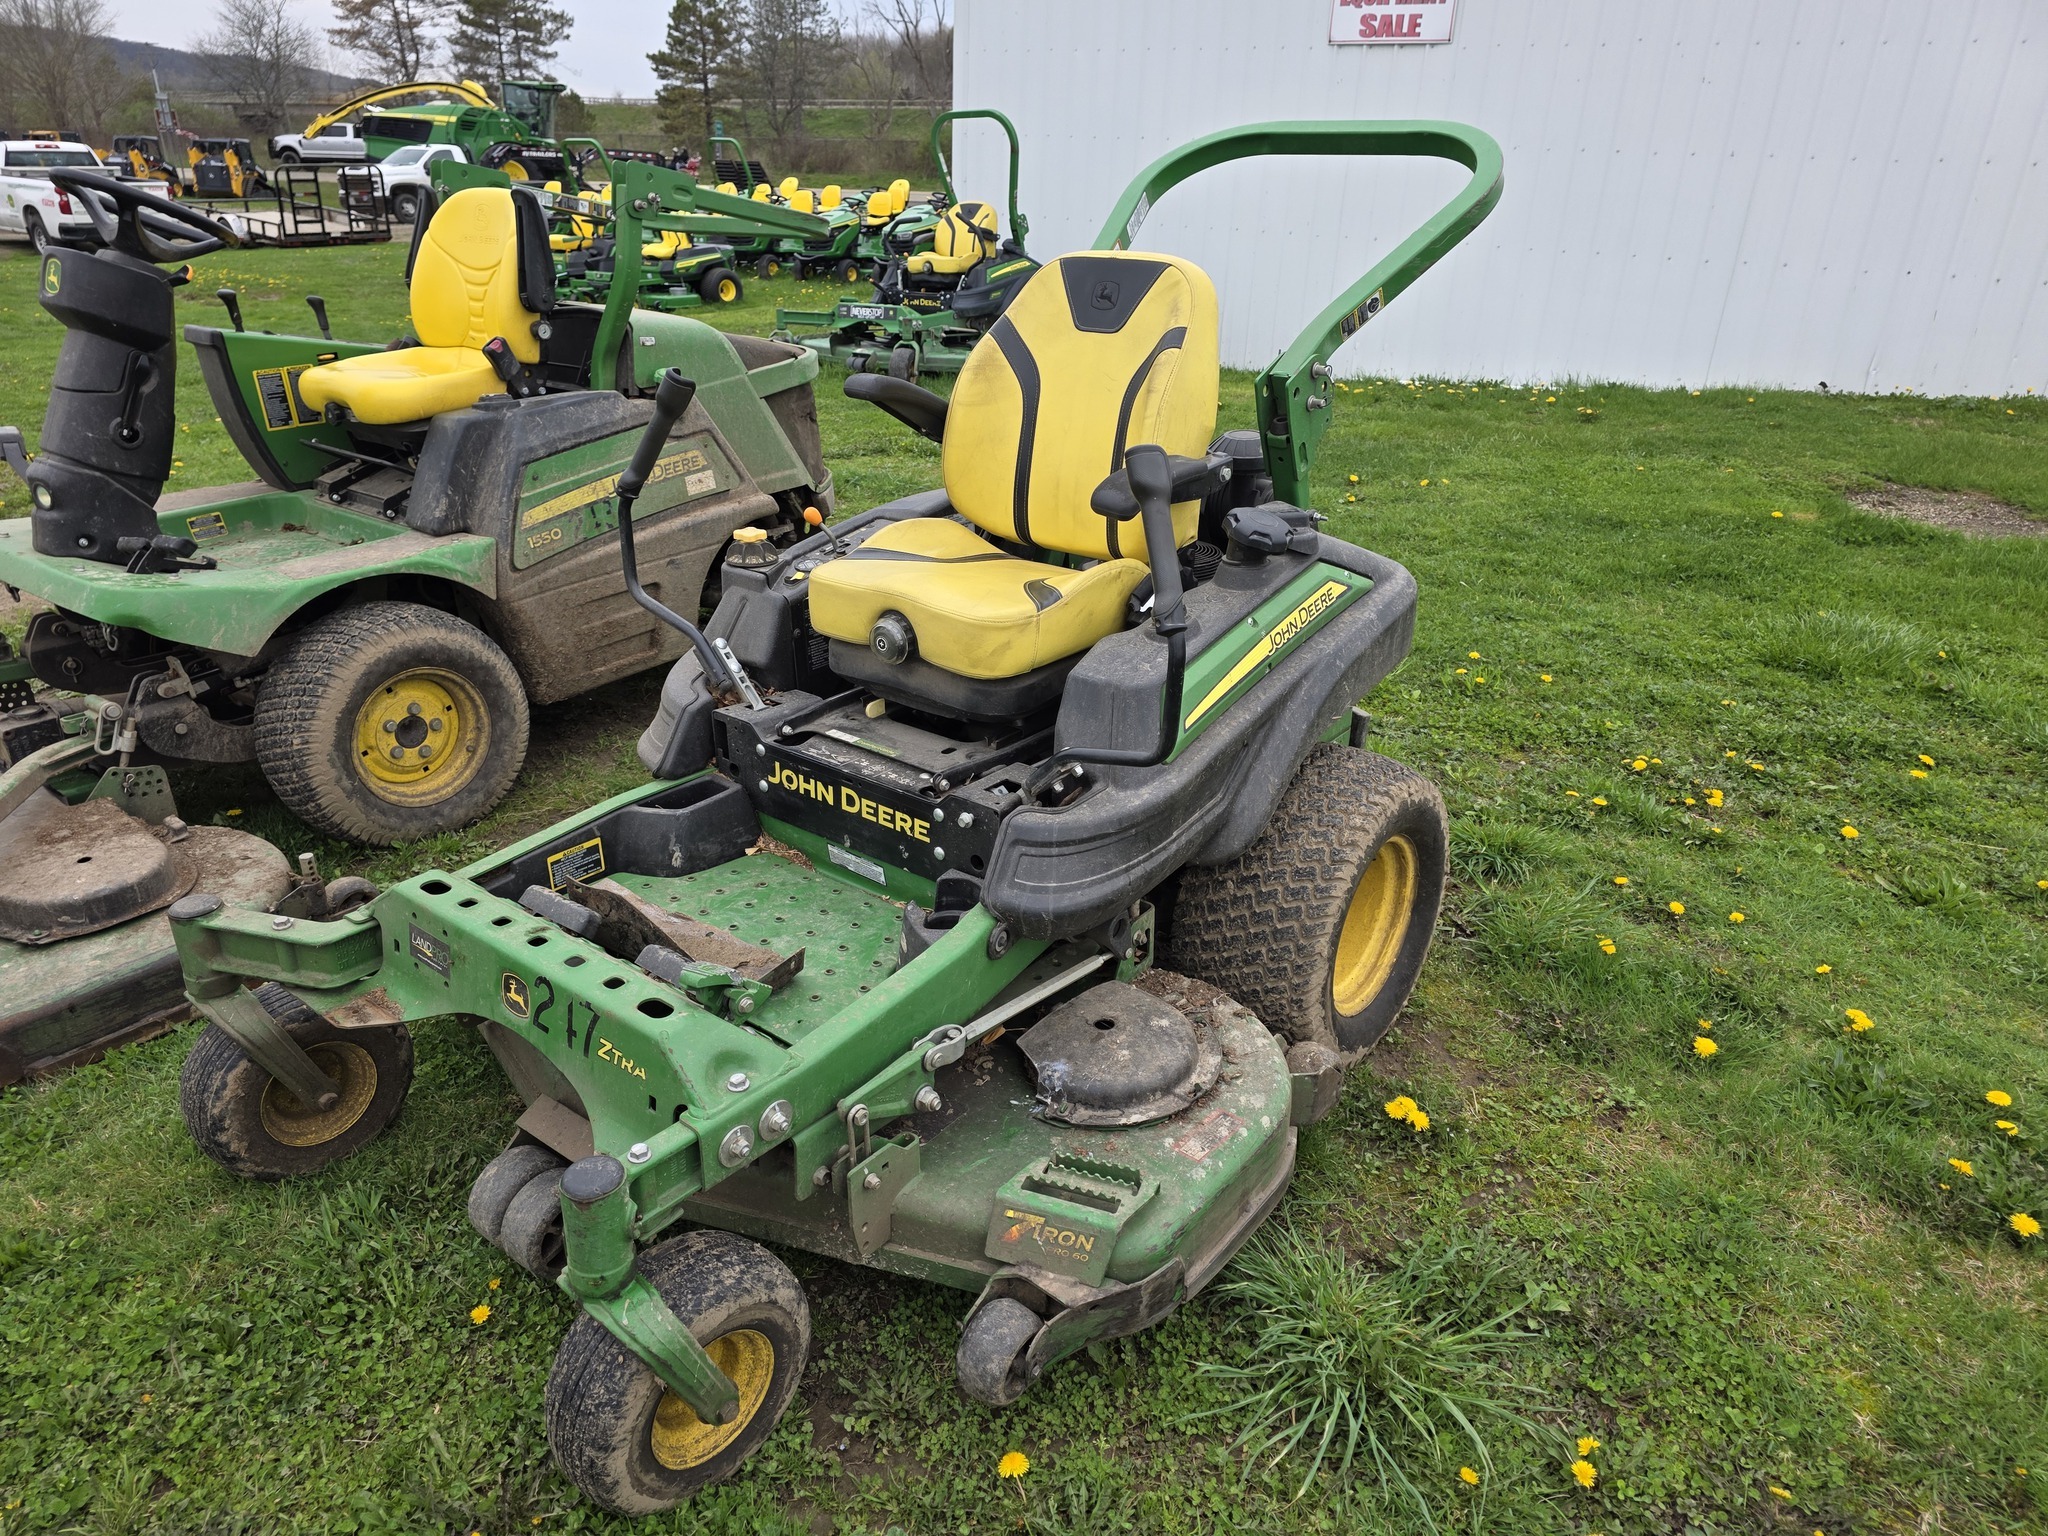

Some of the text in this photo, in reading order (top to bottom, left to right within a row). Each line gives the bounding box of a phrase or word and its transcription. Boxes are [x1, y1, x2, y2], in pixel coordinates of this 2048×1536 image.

[1359, 13, 1423, 38] SALE
[652, 454, 701, 482] DEERE
[527, 527, 562, 549] 1550
[1268, 587, 1335, 654] JOHN DEERE
[767, 760, 834, 806] JOHN
[840, 785, 931, 844] DEERE
[411, 932, 449, 965] LANDPRO
[1072, 1252, 1089, 1262] 60
